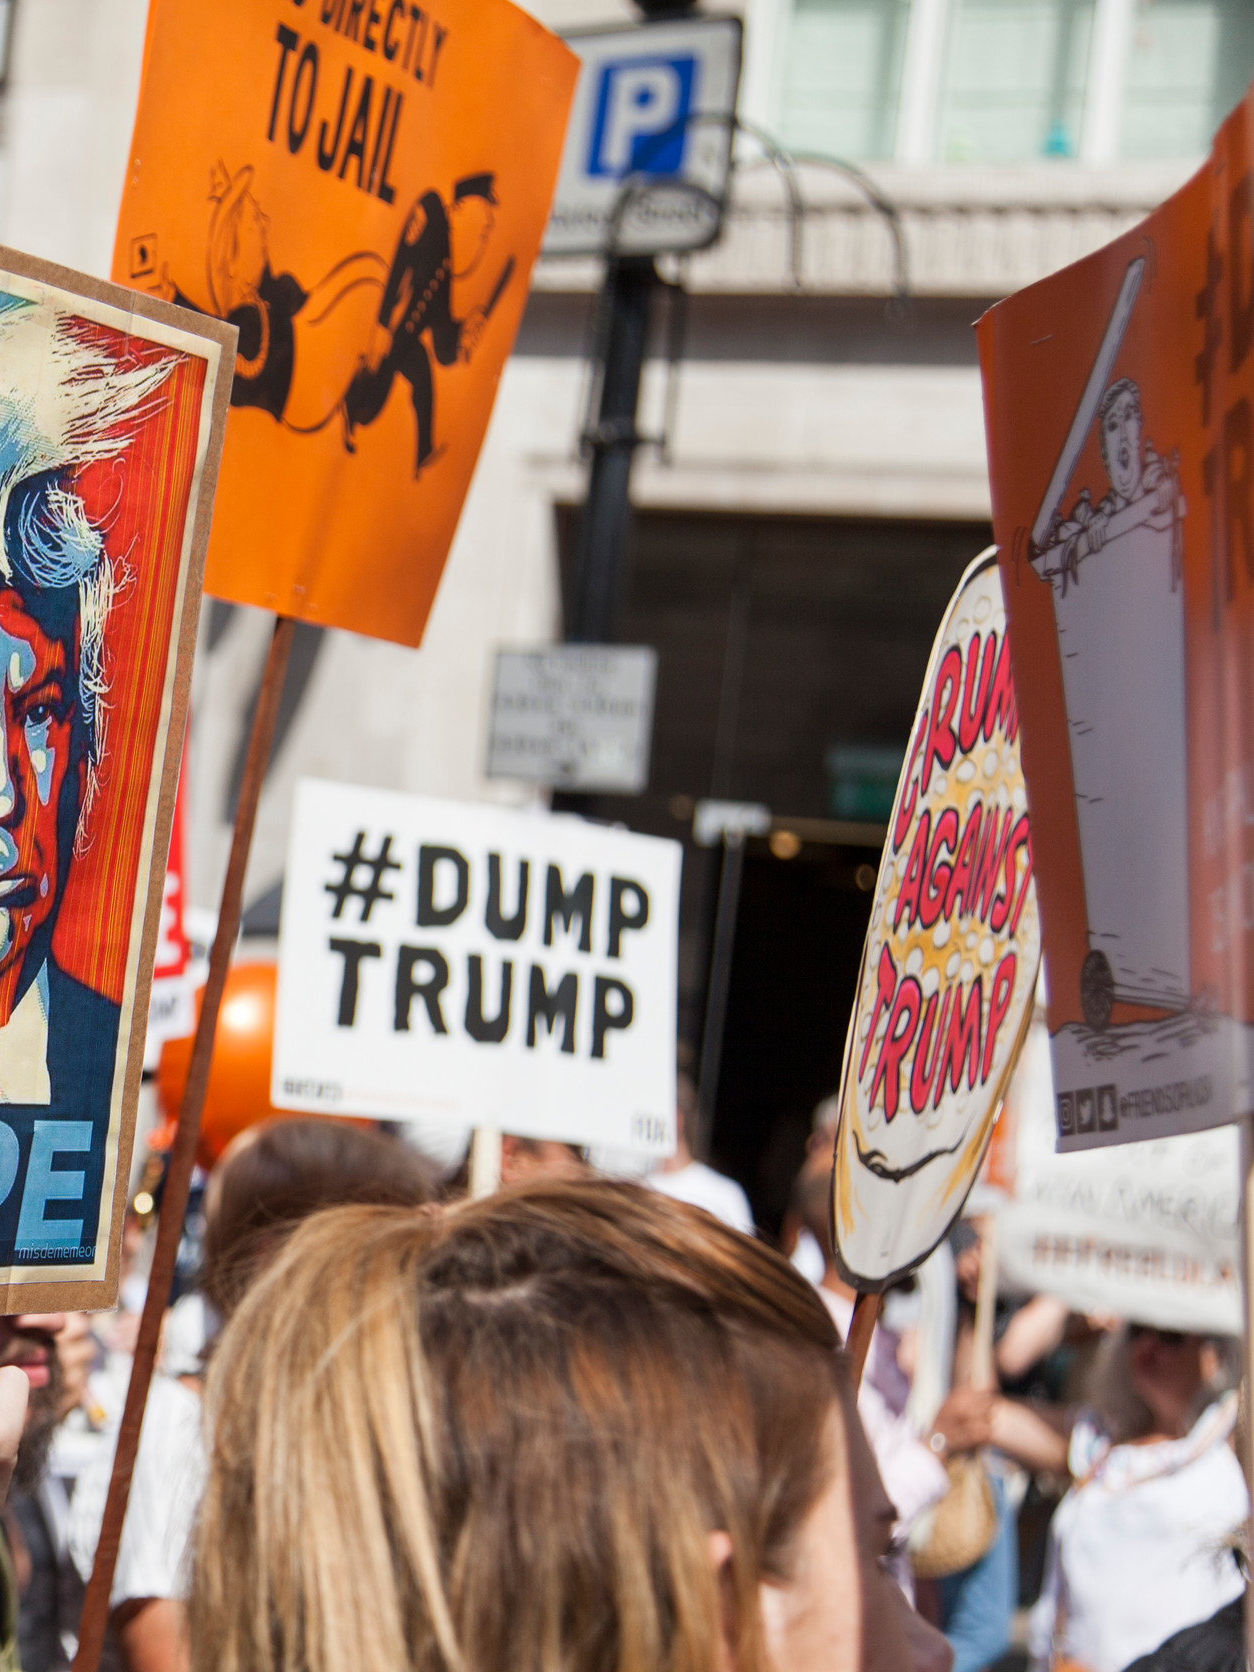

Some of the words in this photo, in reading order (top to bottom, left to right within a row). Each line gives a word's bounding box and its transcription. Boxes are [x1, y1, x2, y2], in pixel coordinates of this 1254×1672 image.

[266, 22, 320, 155] TO
[316, 65, 404, 205] JAIL
[324, 831, 650, 958] #DUMP
[329, 937, 635, 1060] TRUMP
[858, 941, 1017, 1125] TRUMP
